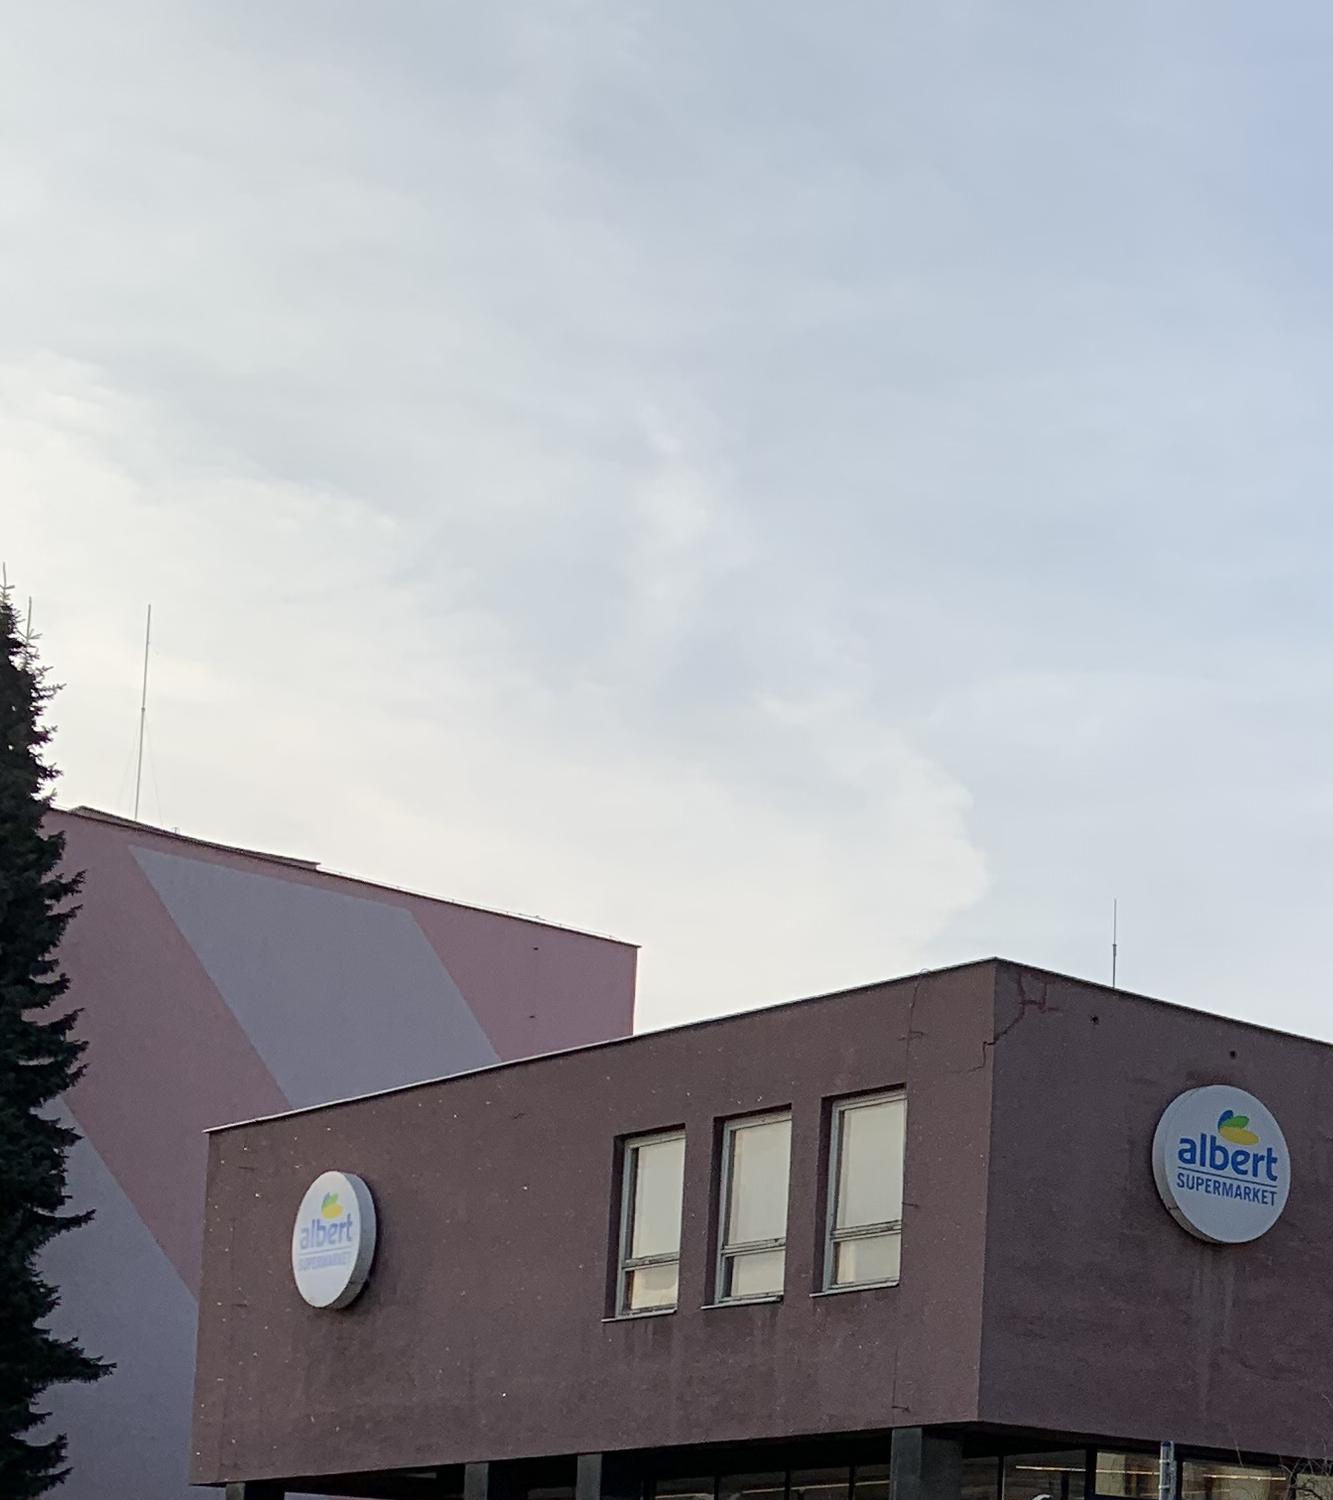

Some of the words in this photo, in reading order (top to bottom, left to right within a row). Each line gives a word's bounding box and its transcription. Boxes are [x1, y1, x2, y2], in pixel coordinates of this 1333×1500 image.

[1178, 1133, 1278, 1182] albert
[1176, 1172, 1277, 1206] SUPERMARKET
[300, 1213, 353, 1249] albert
